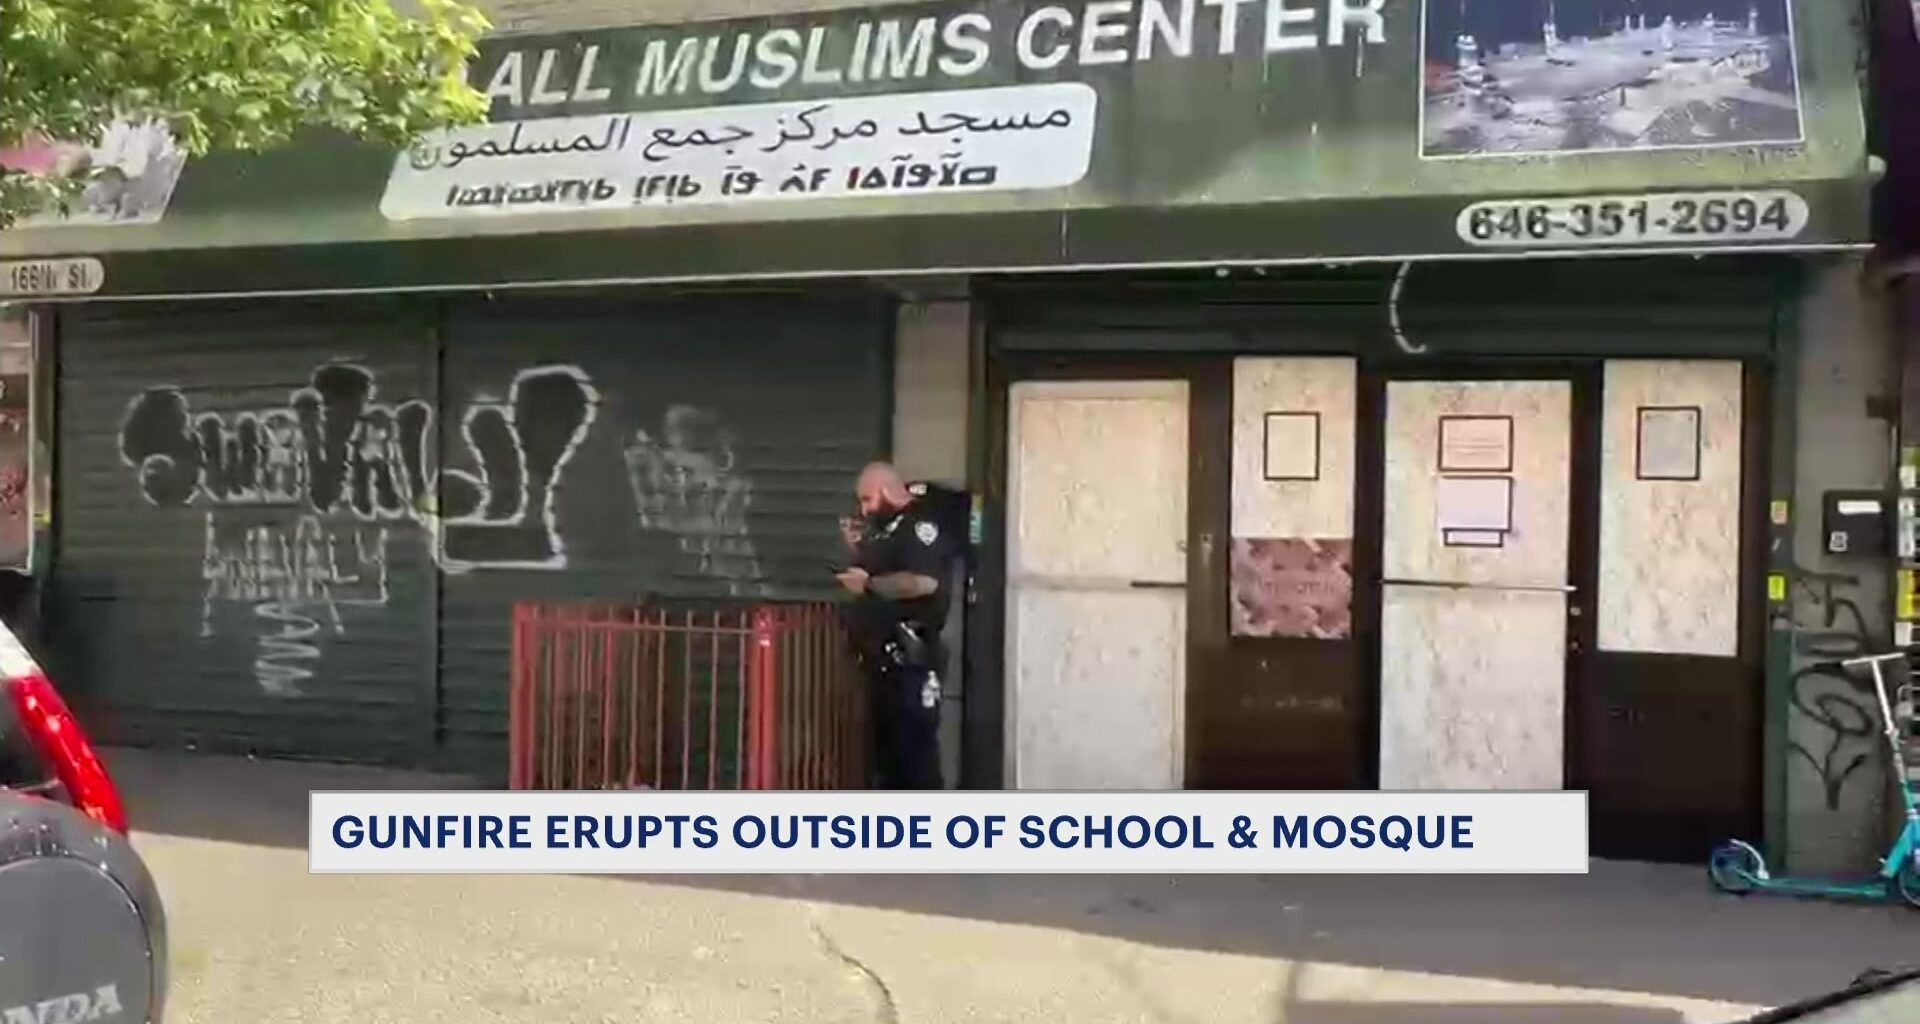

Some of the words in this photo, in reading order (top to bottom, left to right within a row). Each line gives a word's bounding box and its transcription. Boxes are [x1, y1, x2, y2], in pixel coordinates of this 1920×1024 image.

[486, 45, 611, 107] ALL
[635, 13, 991, 97] MUSLIMS
[1016, 0, 1387, 70] CENTER
[643, 125, 754, 162] جمع
[760, 105, 878, 152] مركز
[898, 108, 1071, 143] مسجد
[1469, 197, 1791, 240] 646-351-2694
